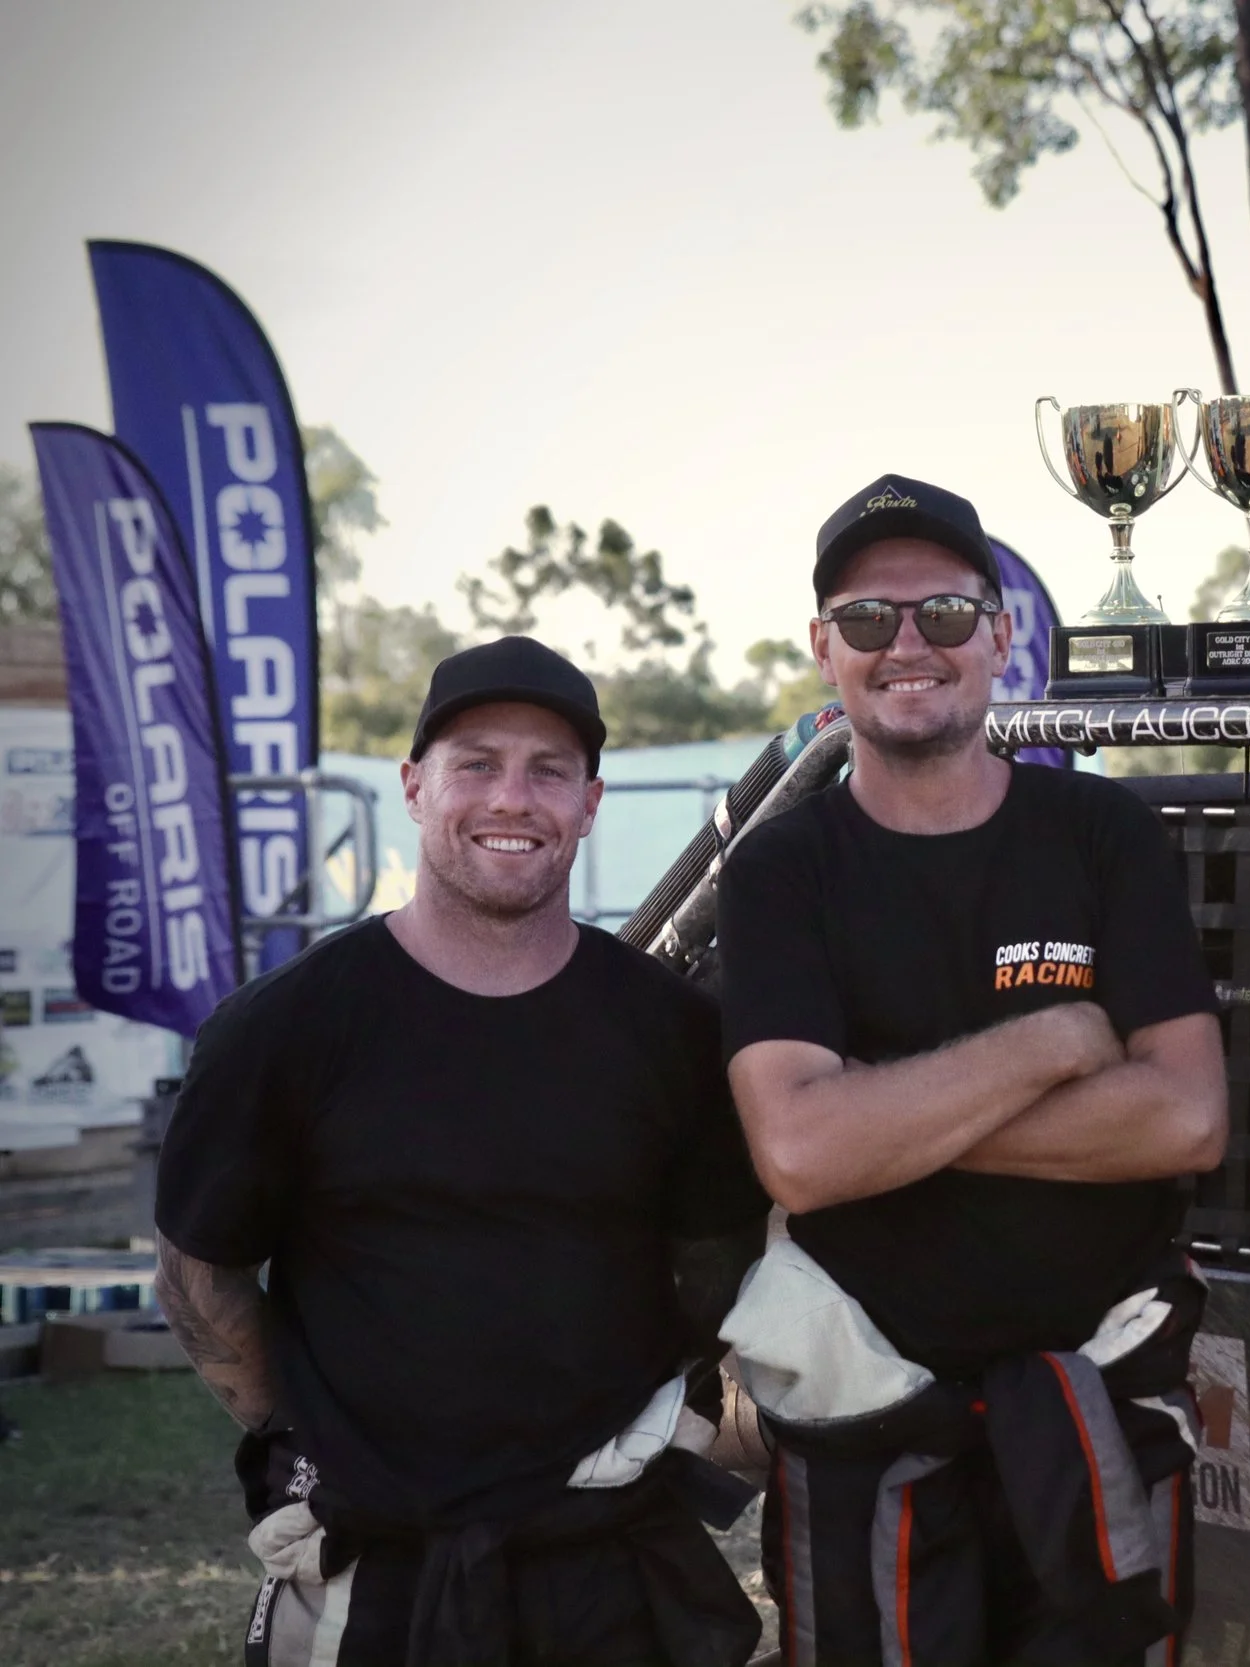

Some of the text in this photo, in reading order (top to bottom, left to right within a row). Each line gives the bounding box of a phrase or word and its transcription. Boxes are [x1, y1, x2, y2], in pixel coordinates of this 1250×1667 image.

[1208, 650, 1244, 658] OUTRIGHT
[1234, 635, 1250, 643] CITY
[205, 403, 298, 917] POLARIS
[984, 708, 1117, 743] MITCH
[108, 497, 210, 991] POLARIS
[102, 782, 142, 994] OFF ROAD
[995, 941, 1096, 966] COOKS CONCRET
[994, 961, 1095, 990] RACING
